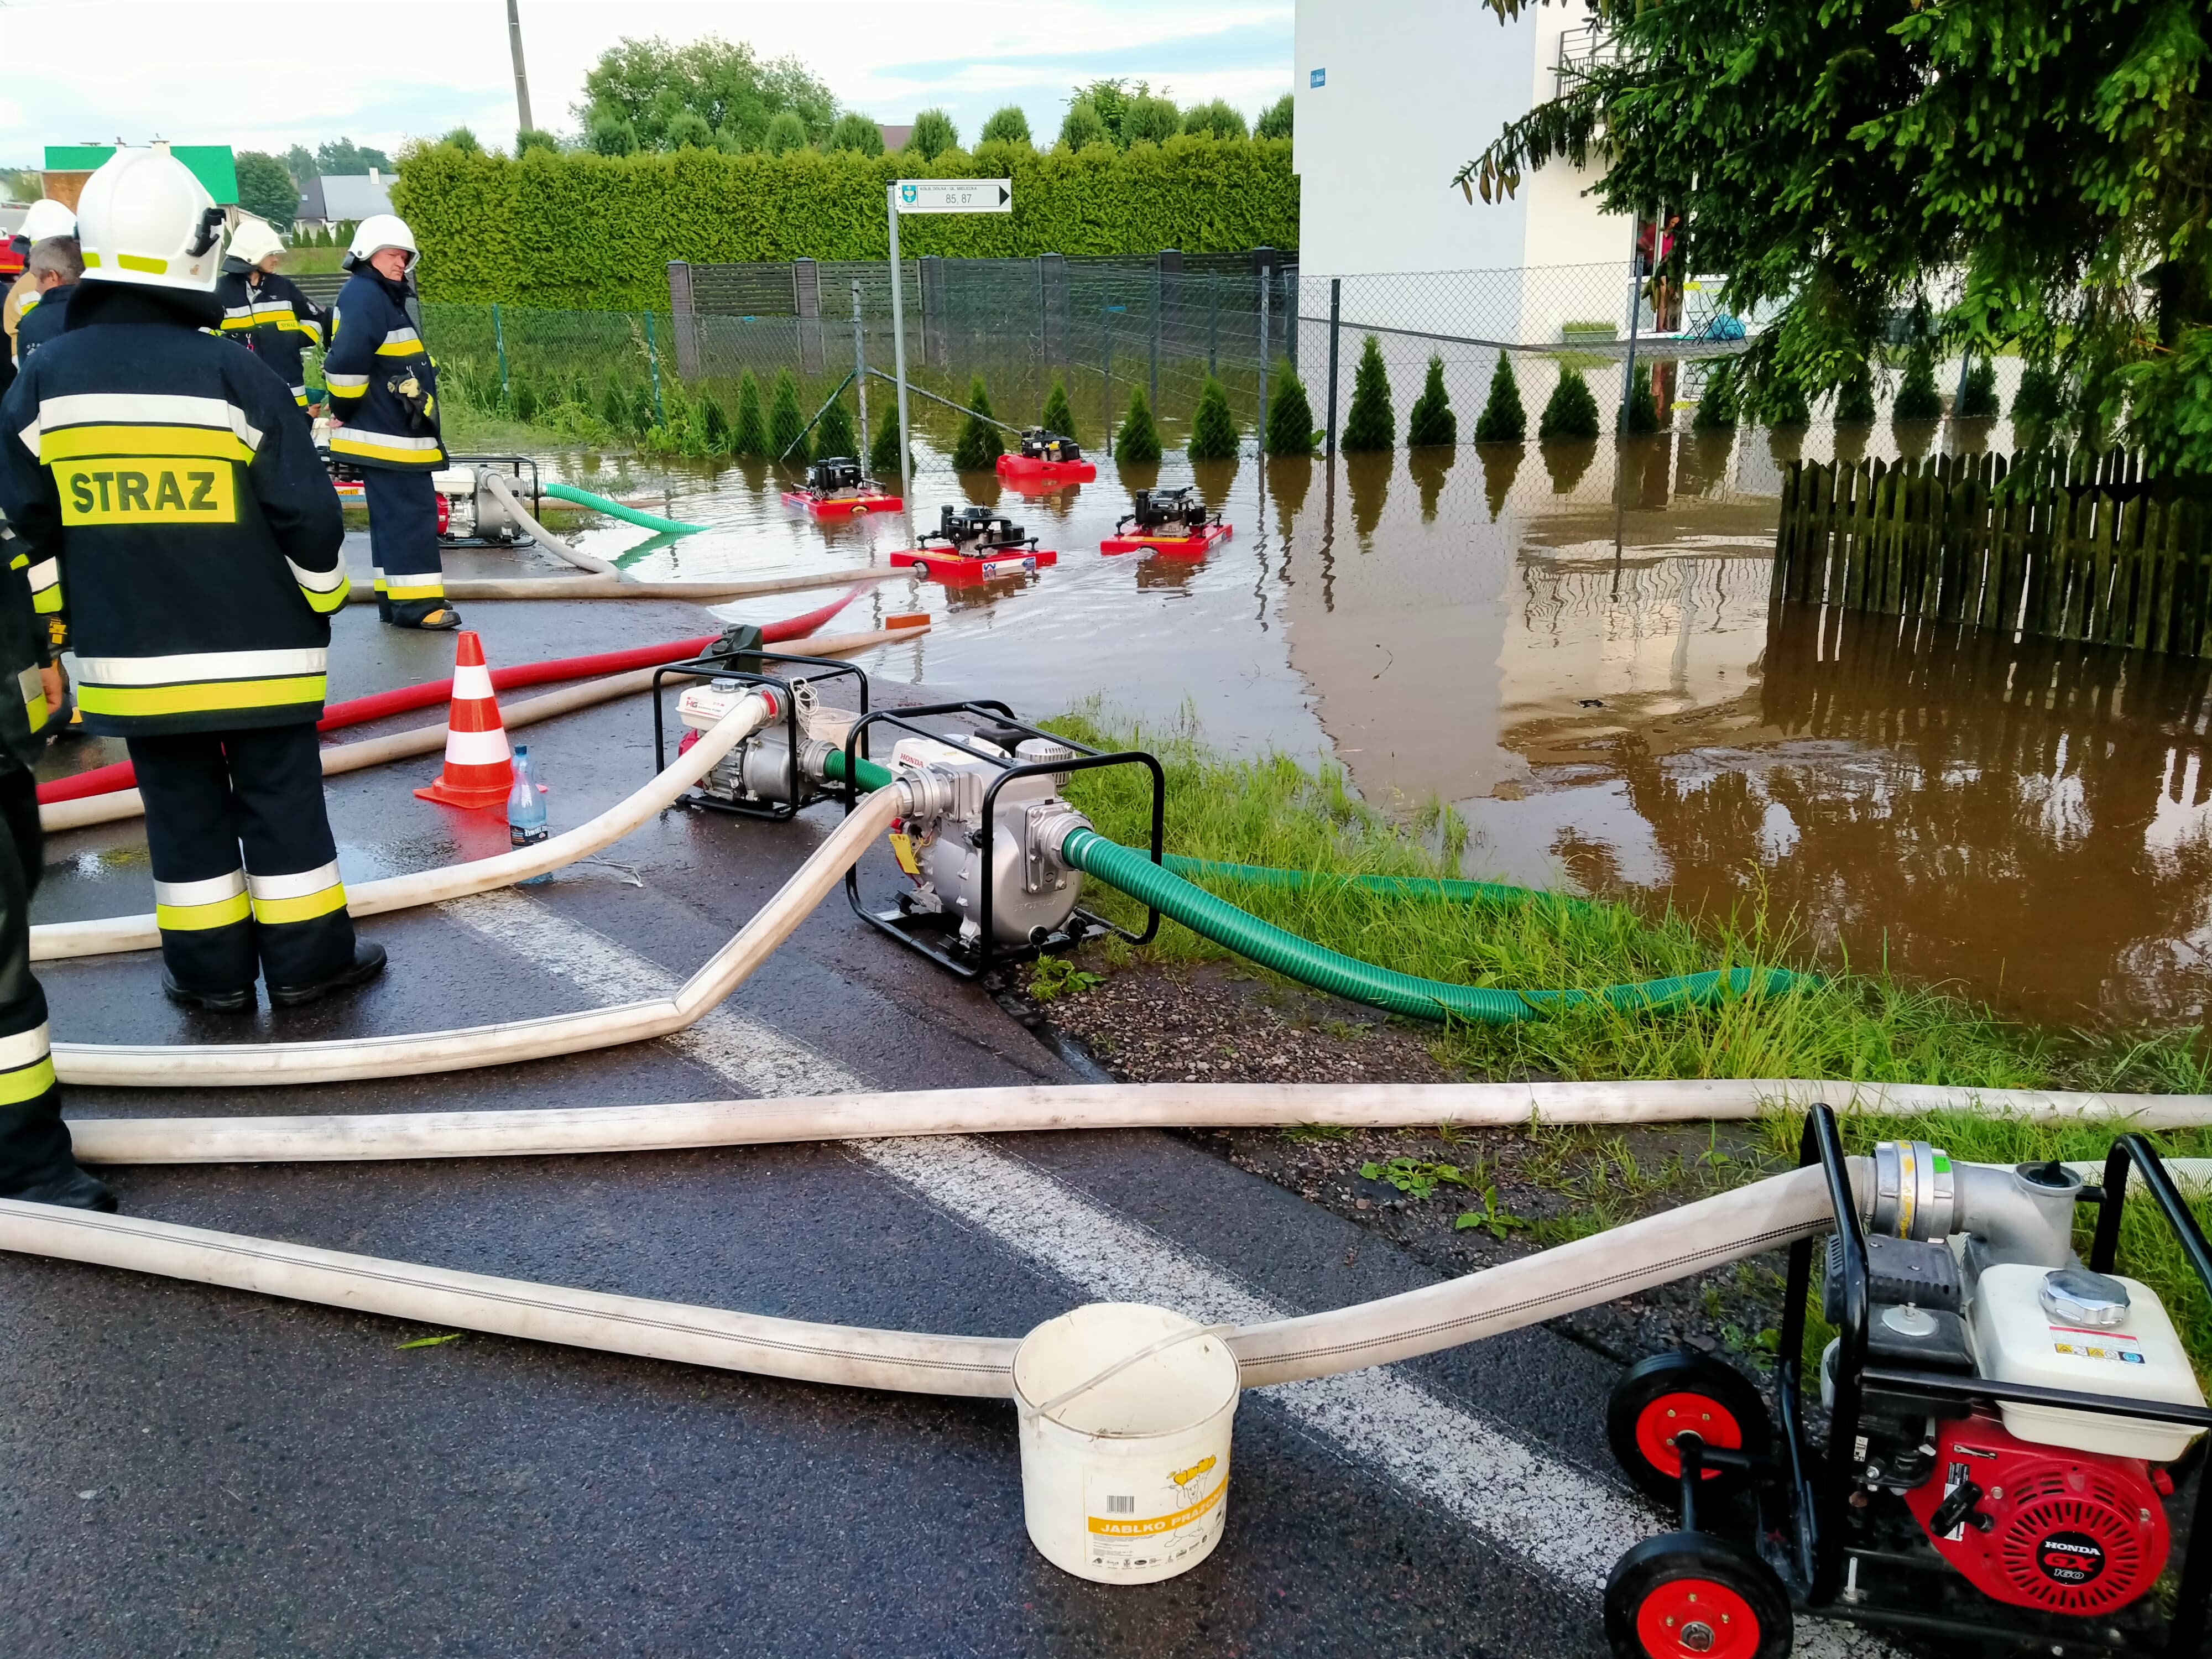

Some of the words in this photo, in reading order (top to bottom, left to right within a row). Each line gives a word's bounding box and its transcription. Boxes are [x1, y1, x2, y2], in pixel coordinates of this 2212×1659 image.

[946, 194, 958, 205] 85,
[961, 194, 972, 204] 87
[900, 753, 924, 768] HONDA
[2044, 1541, 2101, 1556] HONDA
[2043, 1552, 2097, 1572] GX
[2054, 1568, 2084, 1579] 160
